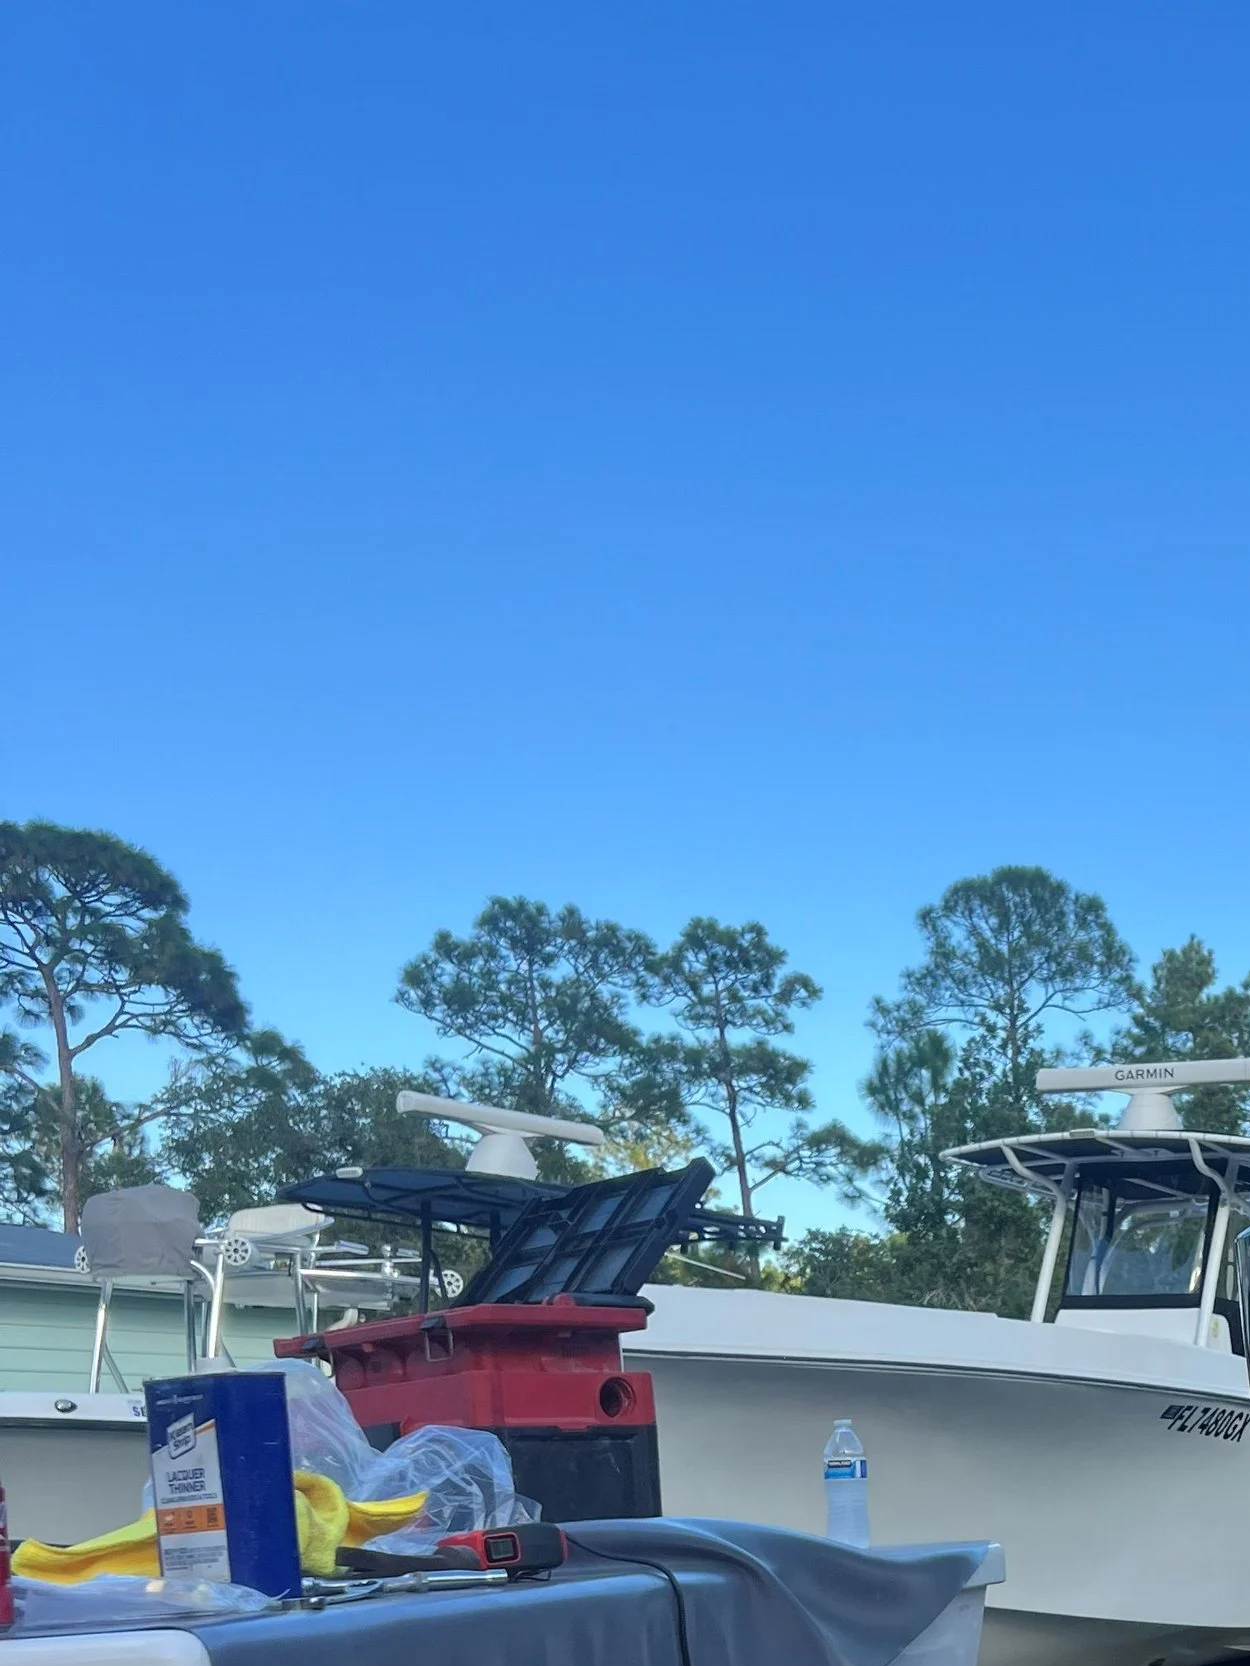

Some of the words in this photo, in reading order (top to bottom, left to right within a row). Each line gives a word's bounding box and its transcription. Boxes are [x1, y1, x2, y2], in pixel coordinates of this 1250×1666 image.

[1115, 1067, 1174, 1081] GARMIN
[166, 1467, 205, 1482] LACQUER
[168, 1480, 206, 1495] THINNER
